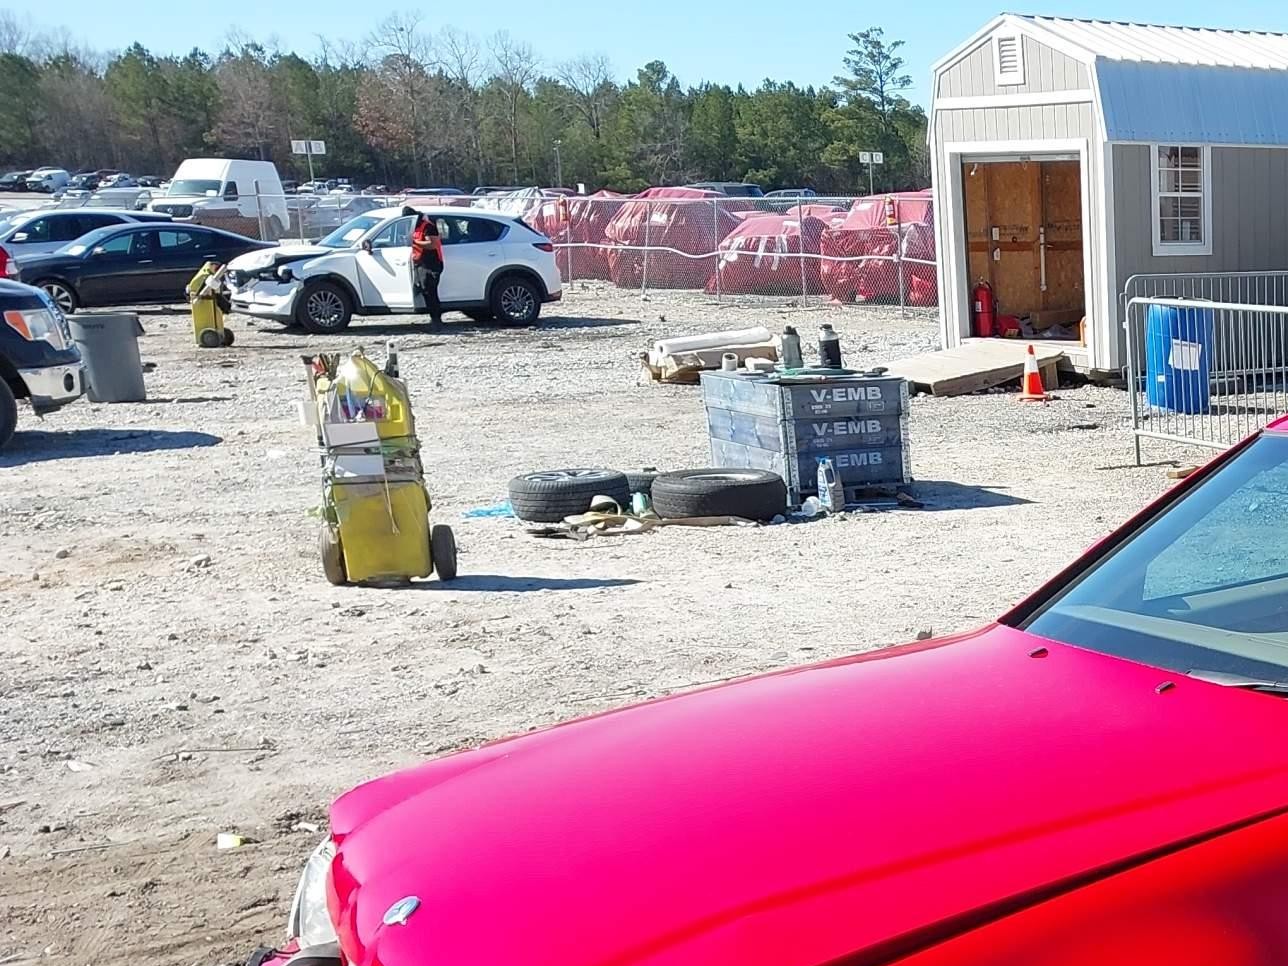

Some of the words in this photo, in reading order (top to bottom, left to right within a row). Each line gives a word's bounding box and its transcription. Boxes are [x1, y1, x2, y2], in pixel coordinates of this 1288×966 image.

[810, 386, 882, 403] V-EMB
[812, 420, 882, 436] V-EMB
[835, 452, 883, 468] EMB
